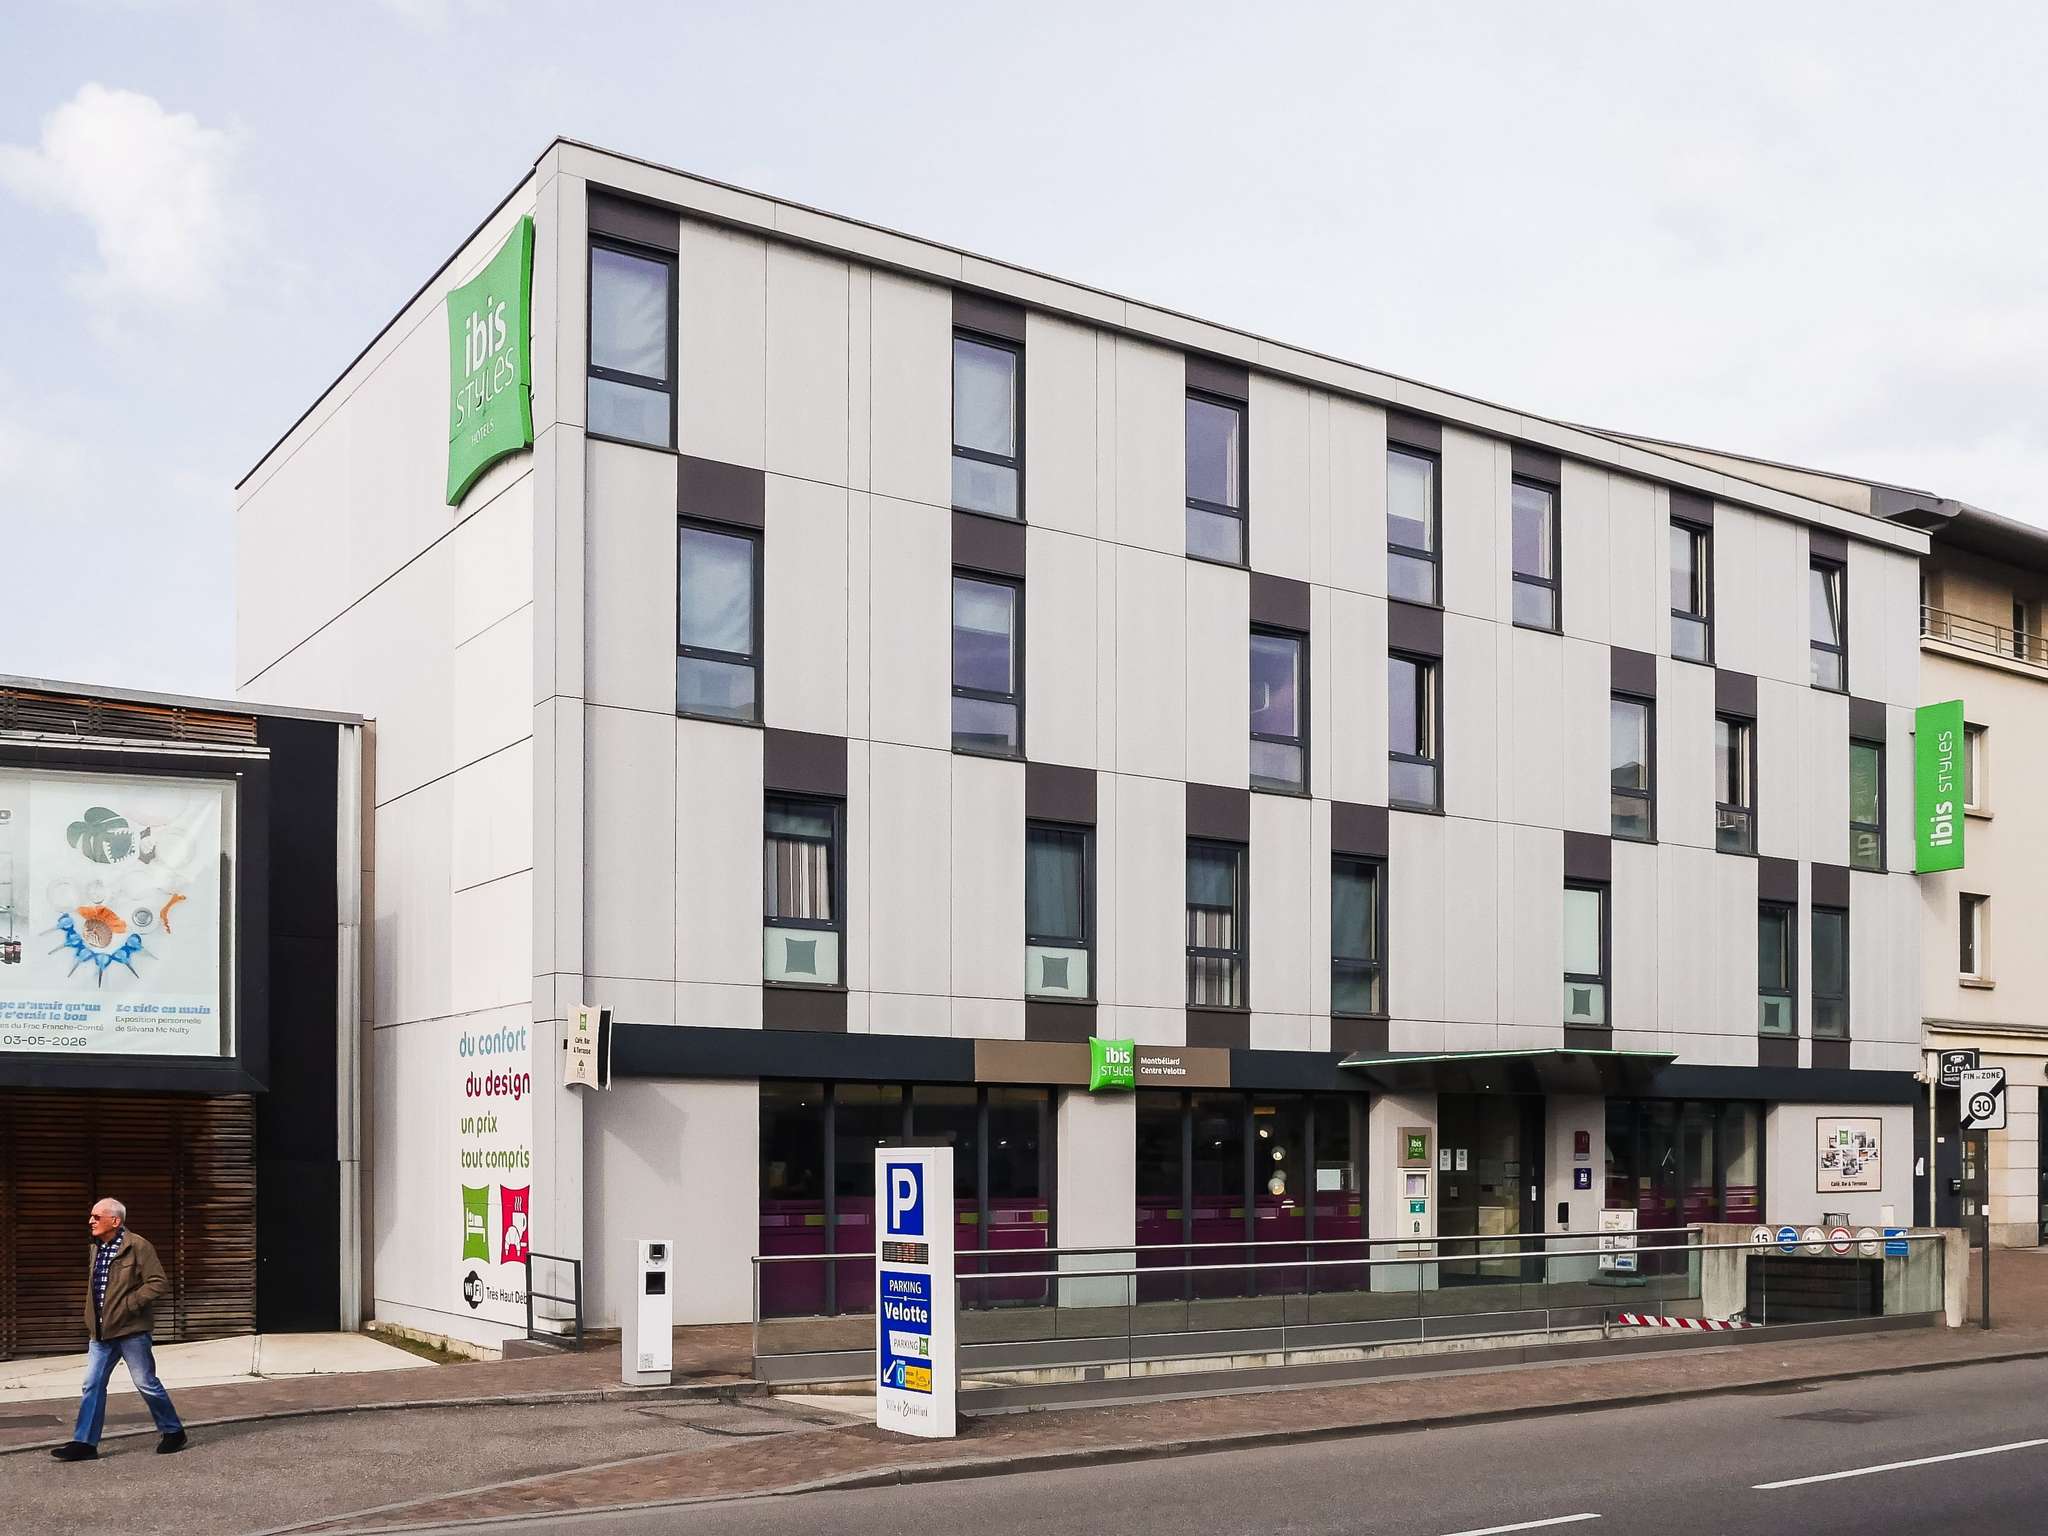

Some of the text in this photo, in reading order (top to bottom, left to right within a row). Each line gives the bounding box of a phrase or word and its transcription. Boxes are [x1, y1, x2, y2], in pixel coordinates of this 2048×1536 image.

[465, 295, 506, 378] ibis
[1930, 801, 1952, 847] ibis
[3, 1035, 87, 1047] 03-05-2026
[460, 1025, 526, 1057] du confort
[1105, 1047, 1131, 1064] ibis
[1140, 1056, 1180, 1066] Montbéliard
[1140, 1066, 1187, 1075] Centre Velotte
[1981, 1072, 2000, 1080] ZONE
[466, 1066, 530, 1101] du design
[1974, 1100, 1991, 1112] 30
[461, 1110, 498, 1138] un prix
[461, 1144, 530, 1174] tout compris
[892, 1168, 918, 1229] P
[499, 1288, 515, 1303] Haut
[889, 1280, 922, 1294] PARKING
[884, 1301, 928, 1323] Velotte
[893, 1338, 919, 1351] PARKING
